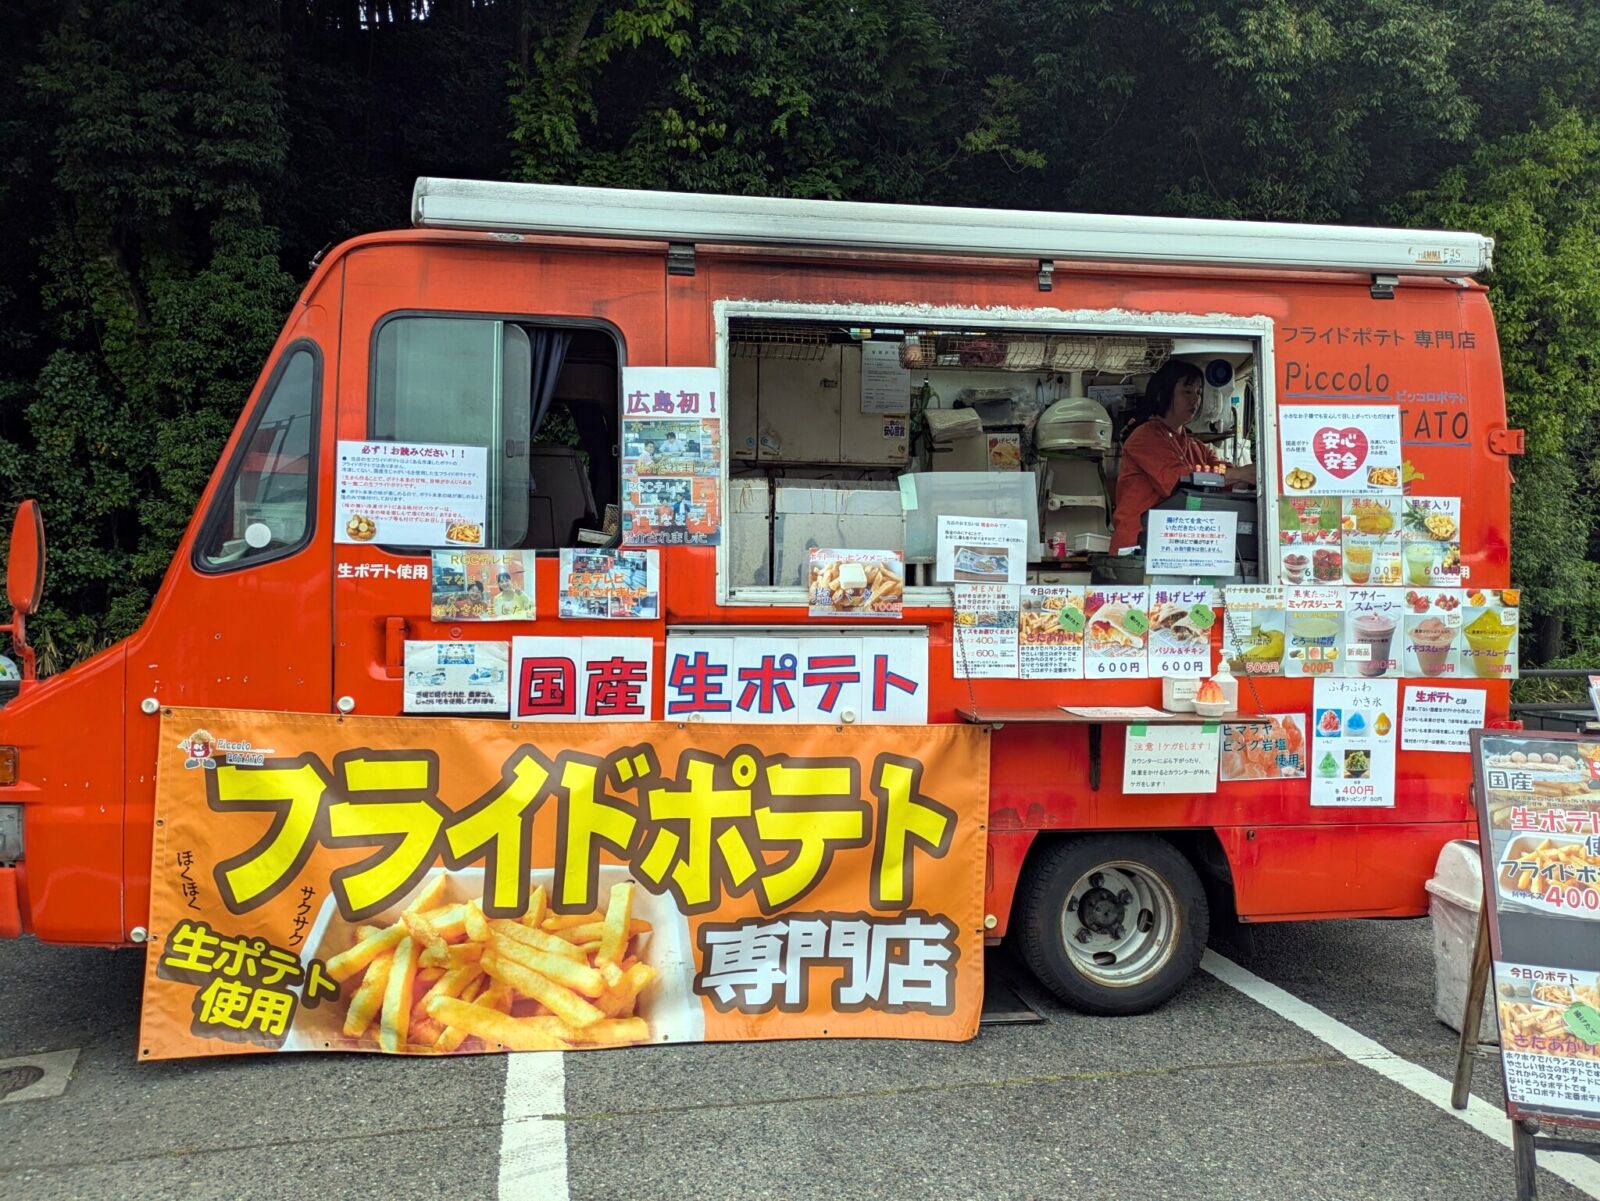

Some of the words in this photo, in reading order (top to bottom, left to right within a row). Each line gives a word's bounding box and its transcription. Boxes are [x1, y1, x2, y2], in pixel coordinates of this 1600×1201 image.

[1281, 327, 1405, 346] フライドポテト
[1414, 330, 1476, 349] 専門店
[1285, 361, 1390, 392] Piccolo
[627, 390, 716, 414] 広島初！
[1396, 391, 1467, 404] ピッコロポテト
[1398, 409, 1469, 439] TATO
[1322, 431, 1357, 449] 安心
[1323, 452, 1358, 470] 安全
[1352, 499, 1391, 508] 果実入り
[1412, 500, 1451, 510] 果実入り
[338, 563, 428, 579] 生ポテト使用
[1093, 592, 1145, 604] 揚げピザ
[1155, 591, 1206, 603] 揚げピザ
[1294, 590, 1339, 598] 果実たっぷり
[1349, 591, 1386, 601] アサイー
[1288, 600, 1343, 609] ミックスジュース
[1354, 602, 1402, 611] スムージー
[1347, 648, 1370, 656] 新商品
[1098, 662, 1140, 672] 600円
[1162, 661, 1203, 671] 600円
[1246, 661, 1280, 673] 500円
[1302, 662, 1334, 673] 600円
[518, 656, 648, 717] 国産
[668, 651, 918, 715] 生ポテト
[1329, 682, 1372, 692] ふわふわ
[1353, 697, 1382, 708] かき氷
[1415, 691, 1454, 703] 生ポテト
[1223, 724, 1273, 736] ヒマラヤ
[1223, 739, 1287, 751] ピンク岩塩
[1275, 754, 1299, 766] 使用
[1488, 771, 1534, 791] 国産
[1342, 786, 1374, 796] 400円
[217, 752, 949, 911] フライドポテト
[177, 851, 201, 911] ほくほく
[1546, 886, 1600, 910] 400
[288, 886, 316, 946] サクサク
[165, 924, 336, 998] 生ポテト
[701, 917, 952, 1007] 専門店
[1510, 967, 1580, 983] 今日のポテト
[200, 980, 293, 1036] 使用
